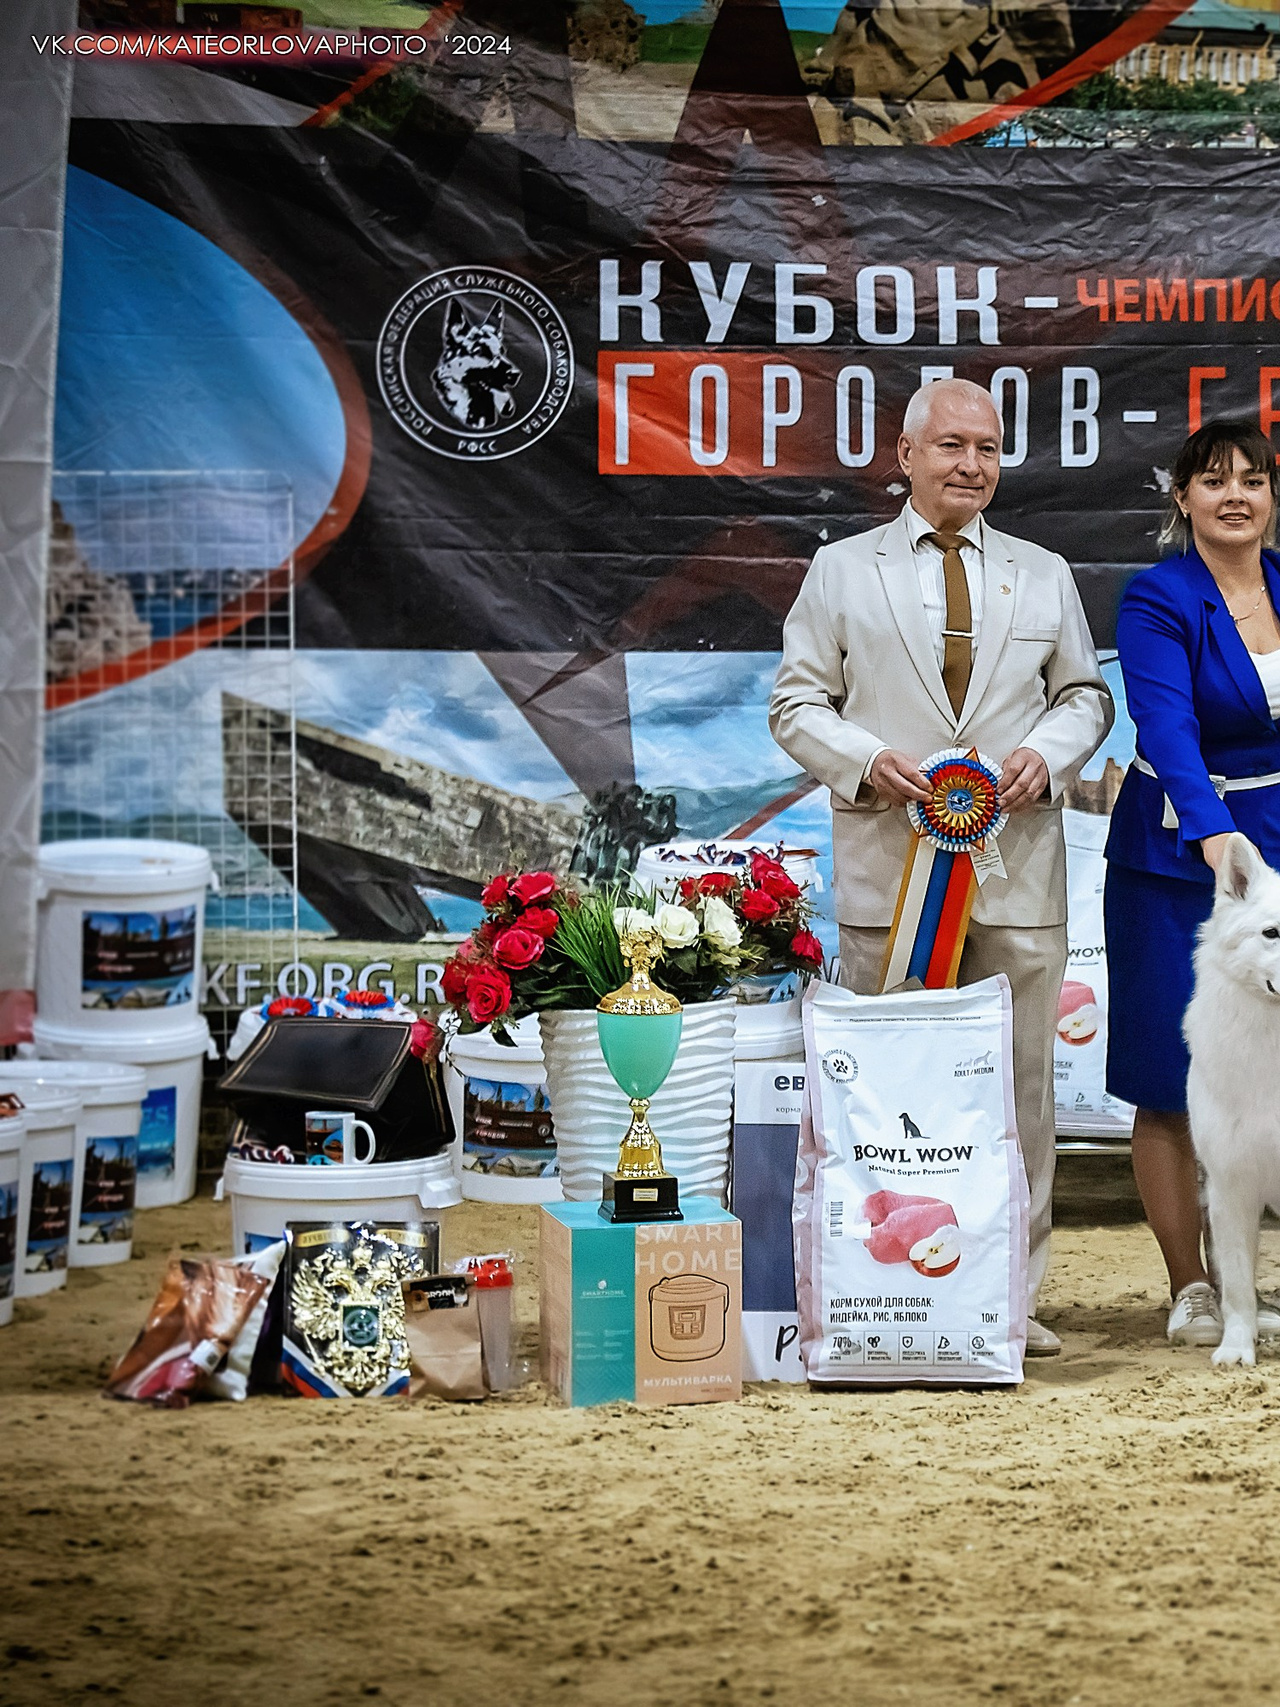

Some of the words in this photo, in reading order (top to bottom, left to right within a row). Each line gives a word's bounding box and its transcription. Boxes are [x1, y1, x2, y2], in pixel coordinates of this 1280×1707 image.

[387, 276, 451, 343] ФЕДЕРАЦИЯ
[454, 273, 549, 319] СЛУЖЕБНОГО
[521, 319, 569, 436] СОБАКОВОДСТВА
[853, 1144, 911, 1163] BOWL
[916, 1145, 974, 1163] WOW
[868, 1165, 896, 1175] Natural
[897, 1169, 920, 1177] Super
[922, 1167, 960, 1176] Premium
[635, 1248, 741, 1275] HOME
[830, 1298, 852, 1309] КОРМ
[854, 1296, 883, 1308] СУХОЙ
[884, 1297, 904, 1309] ДЛЯ
[893, 1311, 928, 1323] ЯБЛОКО
[644, 1374, 733, 1388] МУЛЬТИВАРКА
